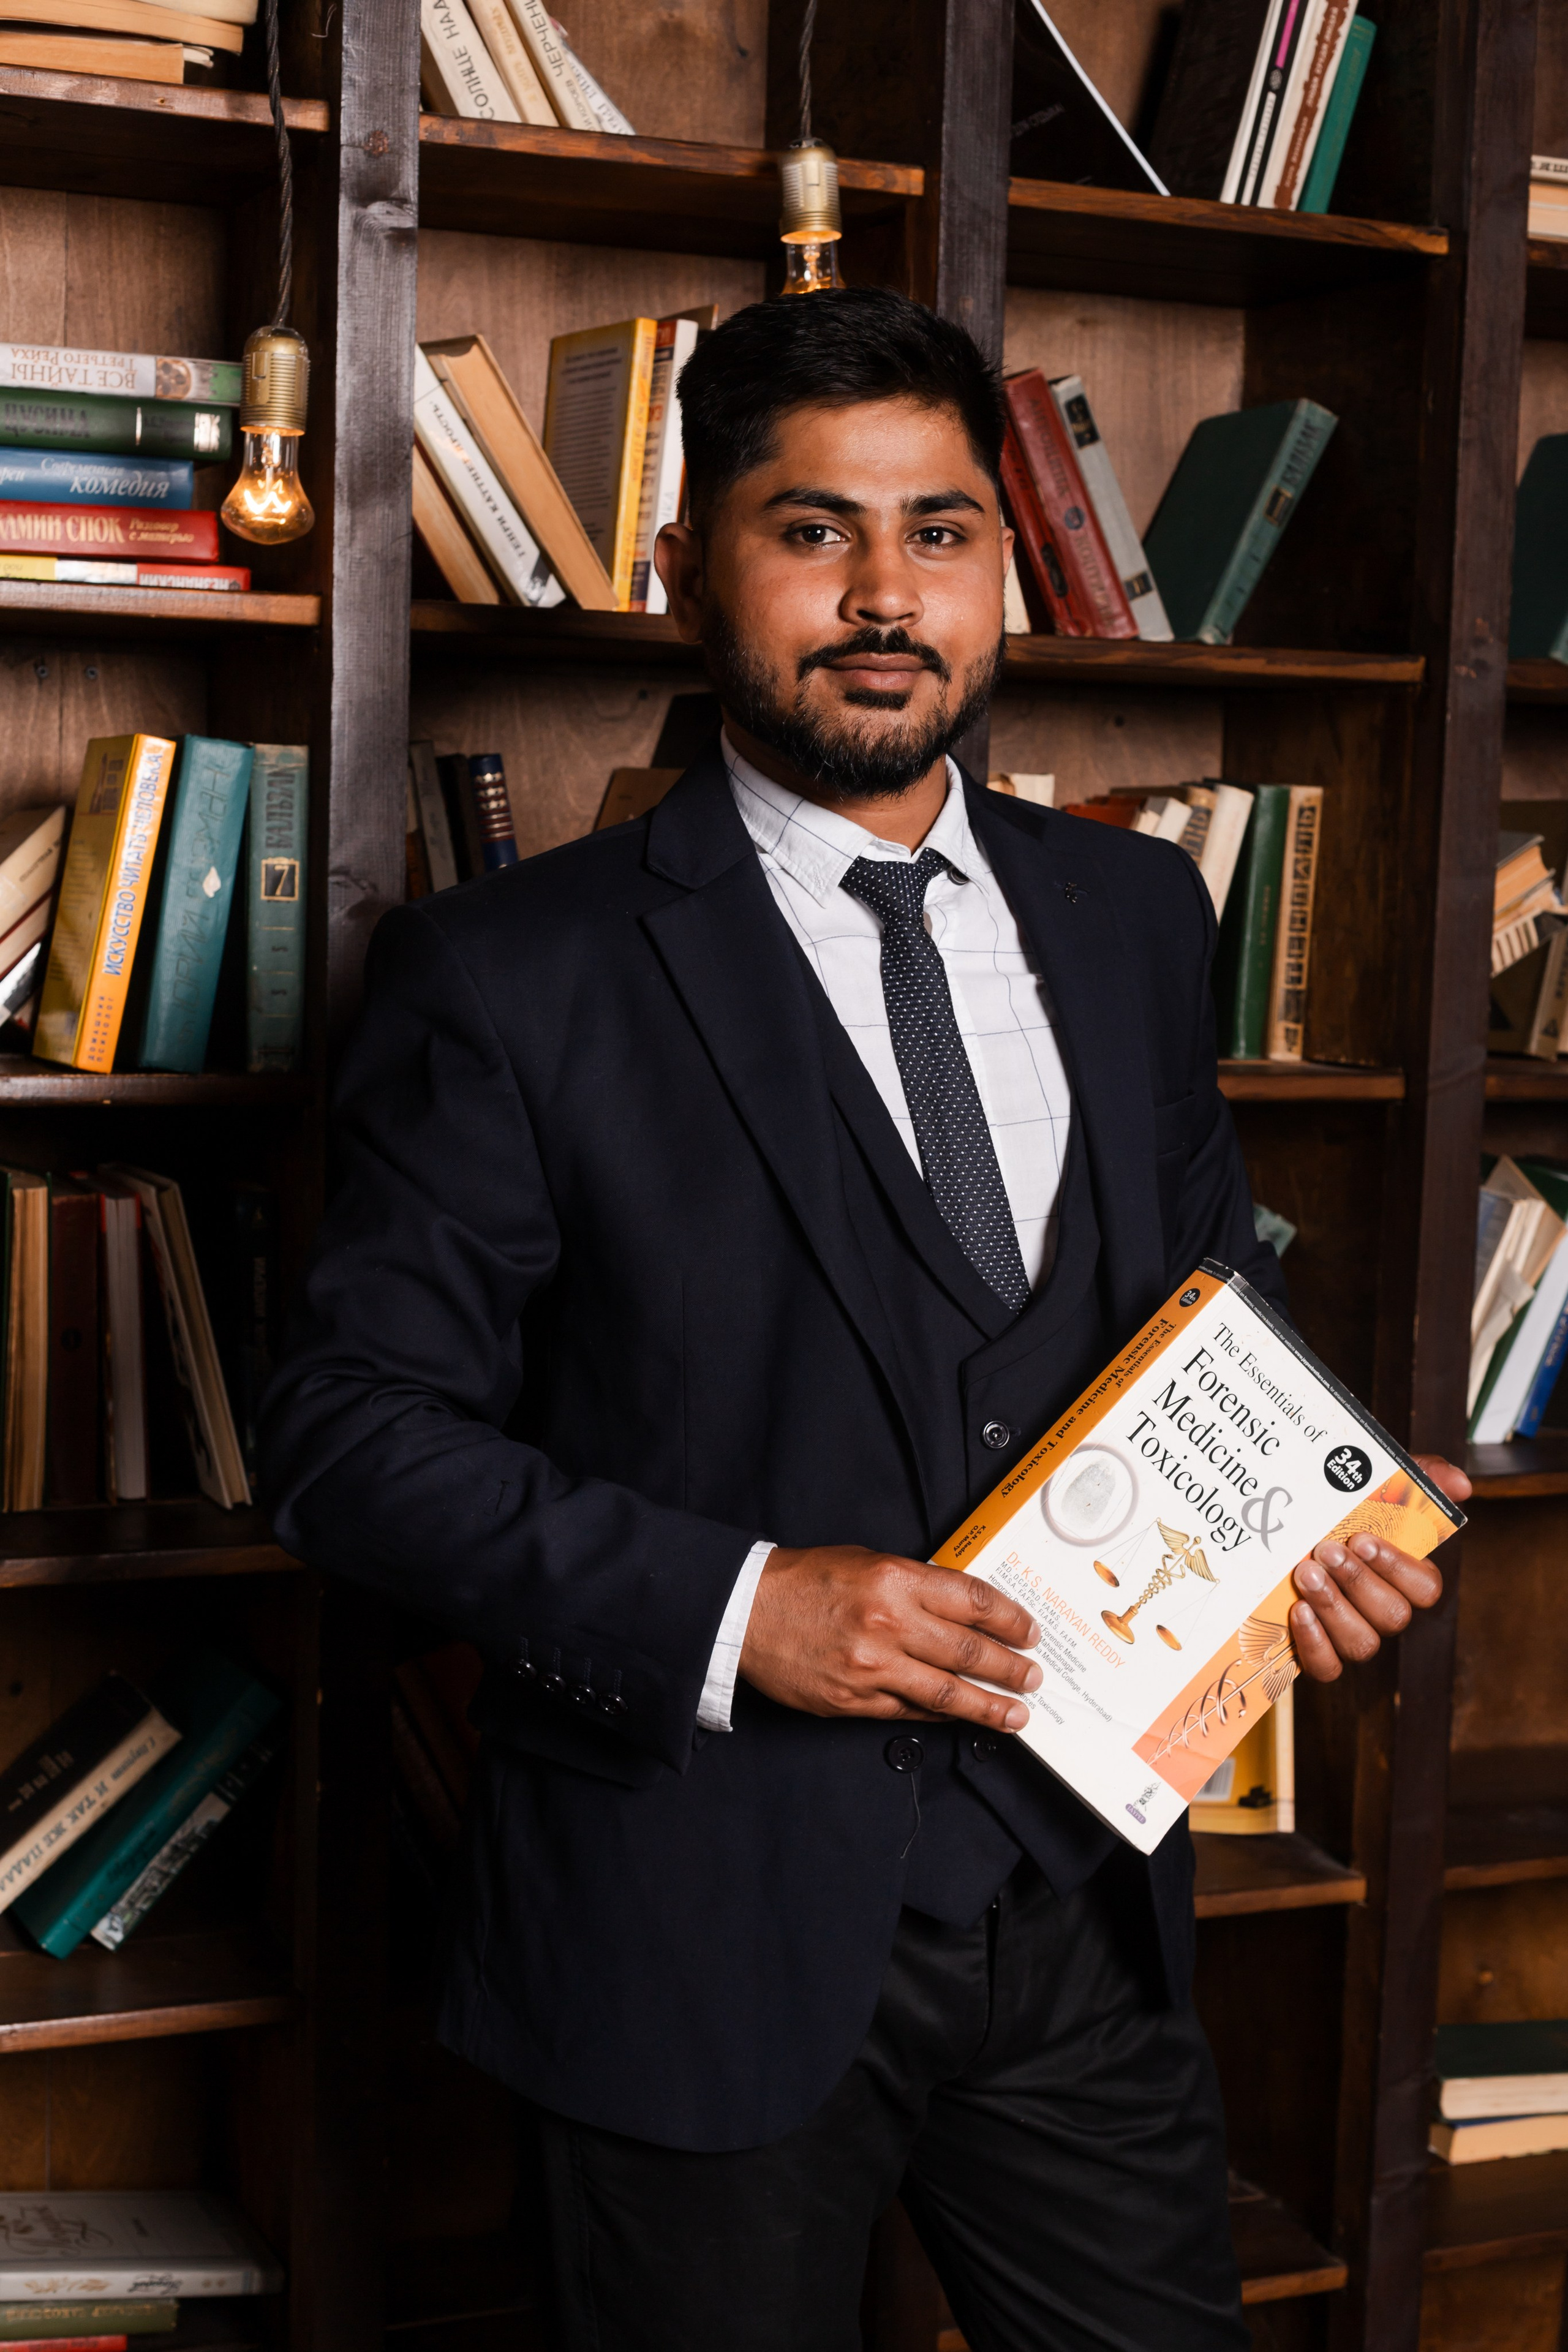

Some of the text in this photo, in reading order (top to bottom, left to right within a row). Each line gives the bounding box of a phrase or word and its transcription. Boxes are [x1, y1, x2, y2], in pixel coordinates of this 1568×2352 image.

[451, 45, 494, 116] СОЛНЦЕ
[9, 362, 137, 390] ВСЕ ТАЙНЫ
[65, 514, 126, 545] СПОК
[496, 515, 526, 557] ГЕНРИ
[102, 752, 163, 976] ИСКУССТВО ЧИТАТЬ ЧЕЛОВЕКА
[274, 865, 289, 895] 7
[1114, 1321, 1177, 1389] The Essentials of
[1182, 1346, 1279, 1455] Forensic
[1213, 1322, 1327, 1442] The Essentials of
[998, 1315, 1169, 1500] Forensic Medicine and Toxicology
[1126, 1411, 1251, 1551] Toxicology
[1152, 1378, 1292, 1552] Medicine &
[1327, 1459, 1354, 1489] Edition
[1335, 1448, 1362, 1483] 34th
[952, 1525, 979, 1552] O.P. Murty
[954, 1525, 986, 1558] K.S.N. Reddy
[1000, 1561, 1011, 1576] M.D.,
[1028, 1588, 1040, 1604] Ph.D.,
[1006, 1551, 1021, 1570] Dr.
[1021, 1566, 1041, 1591] K.S.
[1042, 1587, 1091, 1636] NARAYAN
[1088, 1632, 1125, 1668] REDDY
[1037, 1638, 1075, 1673] Mahabubnagar
[1041, 1627, 1063, 1650] Forensic
[1063, 1648, 1086, 1672] Medicine
[1041, 1652, 1112, 1721] Medical College, Hyderabad)
[1037, 1695, 1065, 1724] Toxicology
